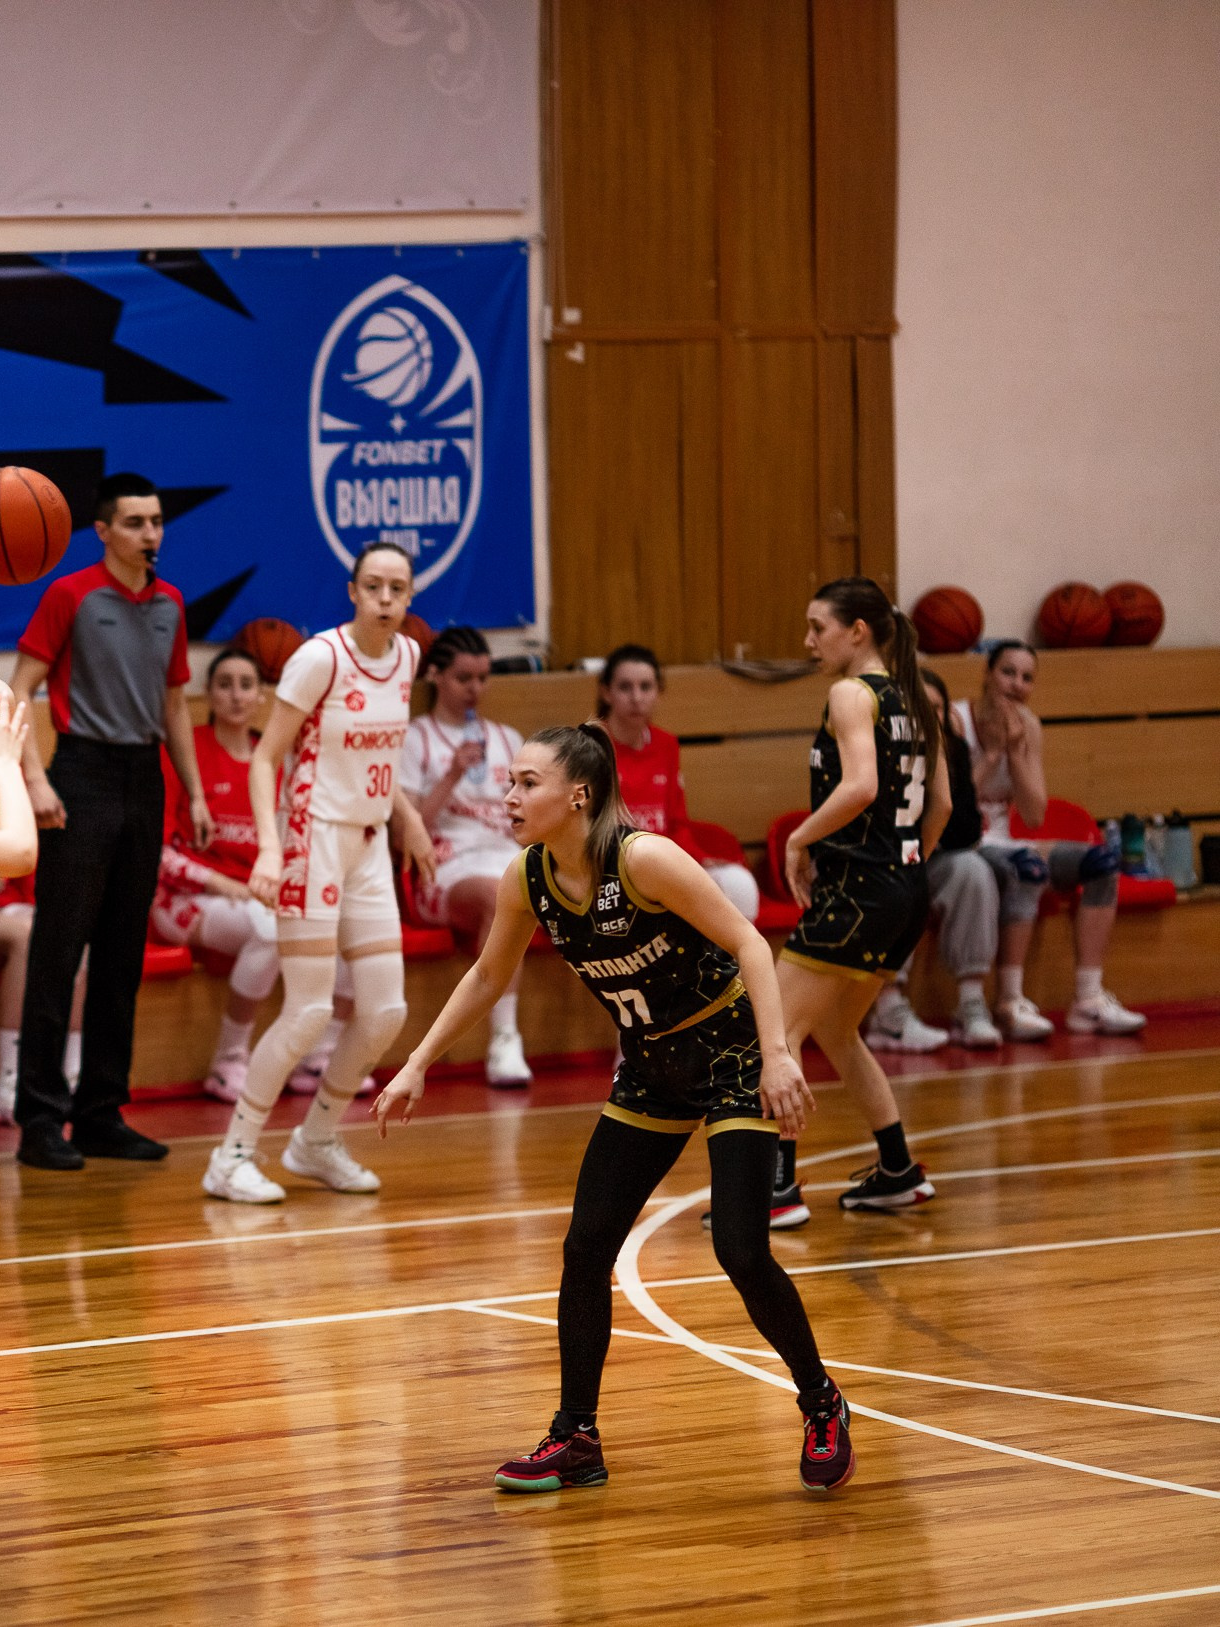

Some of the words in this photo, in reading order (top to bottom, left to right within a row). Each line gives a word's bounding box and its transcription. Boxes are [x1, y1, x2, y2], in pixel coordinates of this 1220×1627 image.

[353, 439, 447, 466] FONBET
[336, 476, 461, 528] ВЫСШАЯ
[366, 763, 392, 797] 30
[895, 755, 927, 827] 3
[597, 894, 620, 911] BET
[598, 881, 620, 898] FON
[568, 934, 671, 979] -АТЛАНТА
